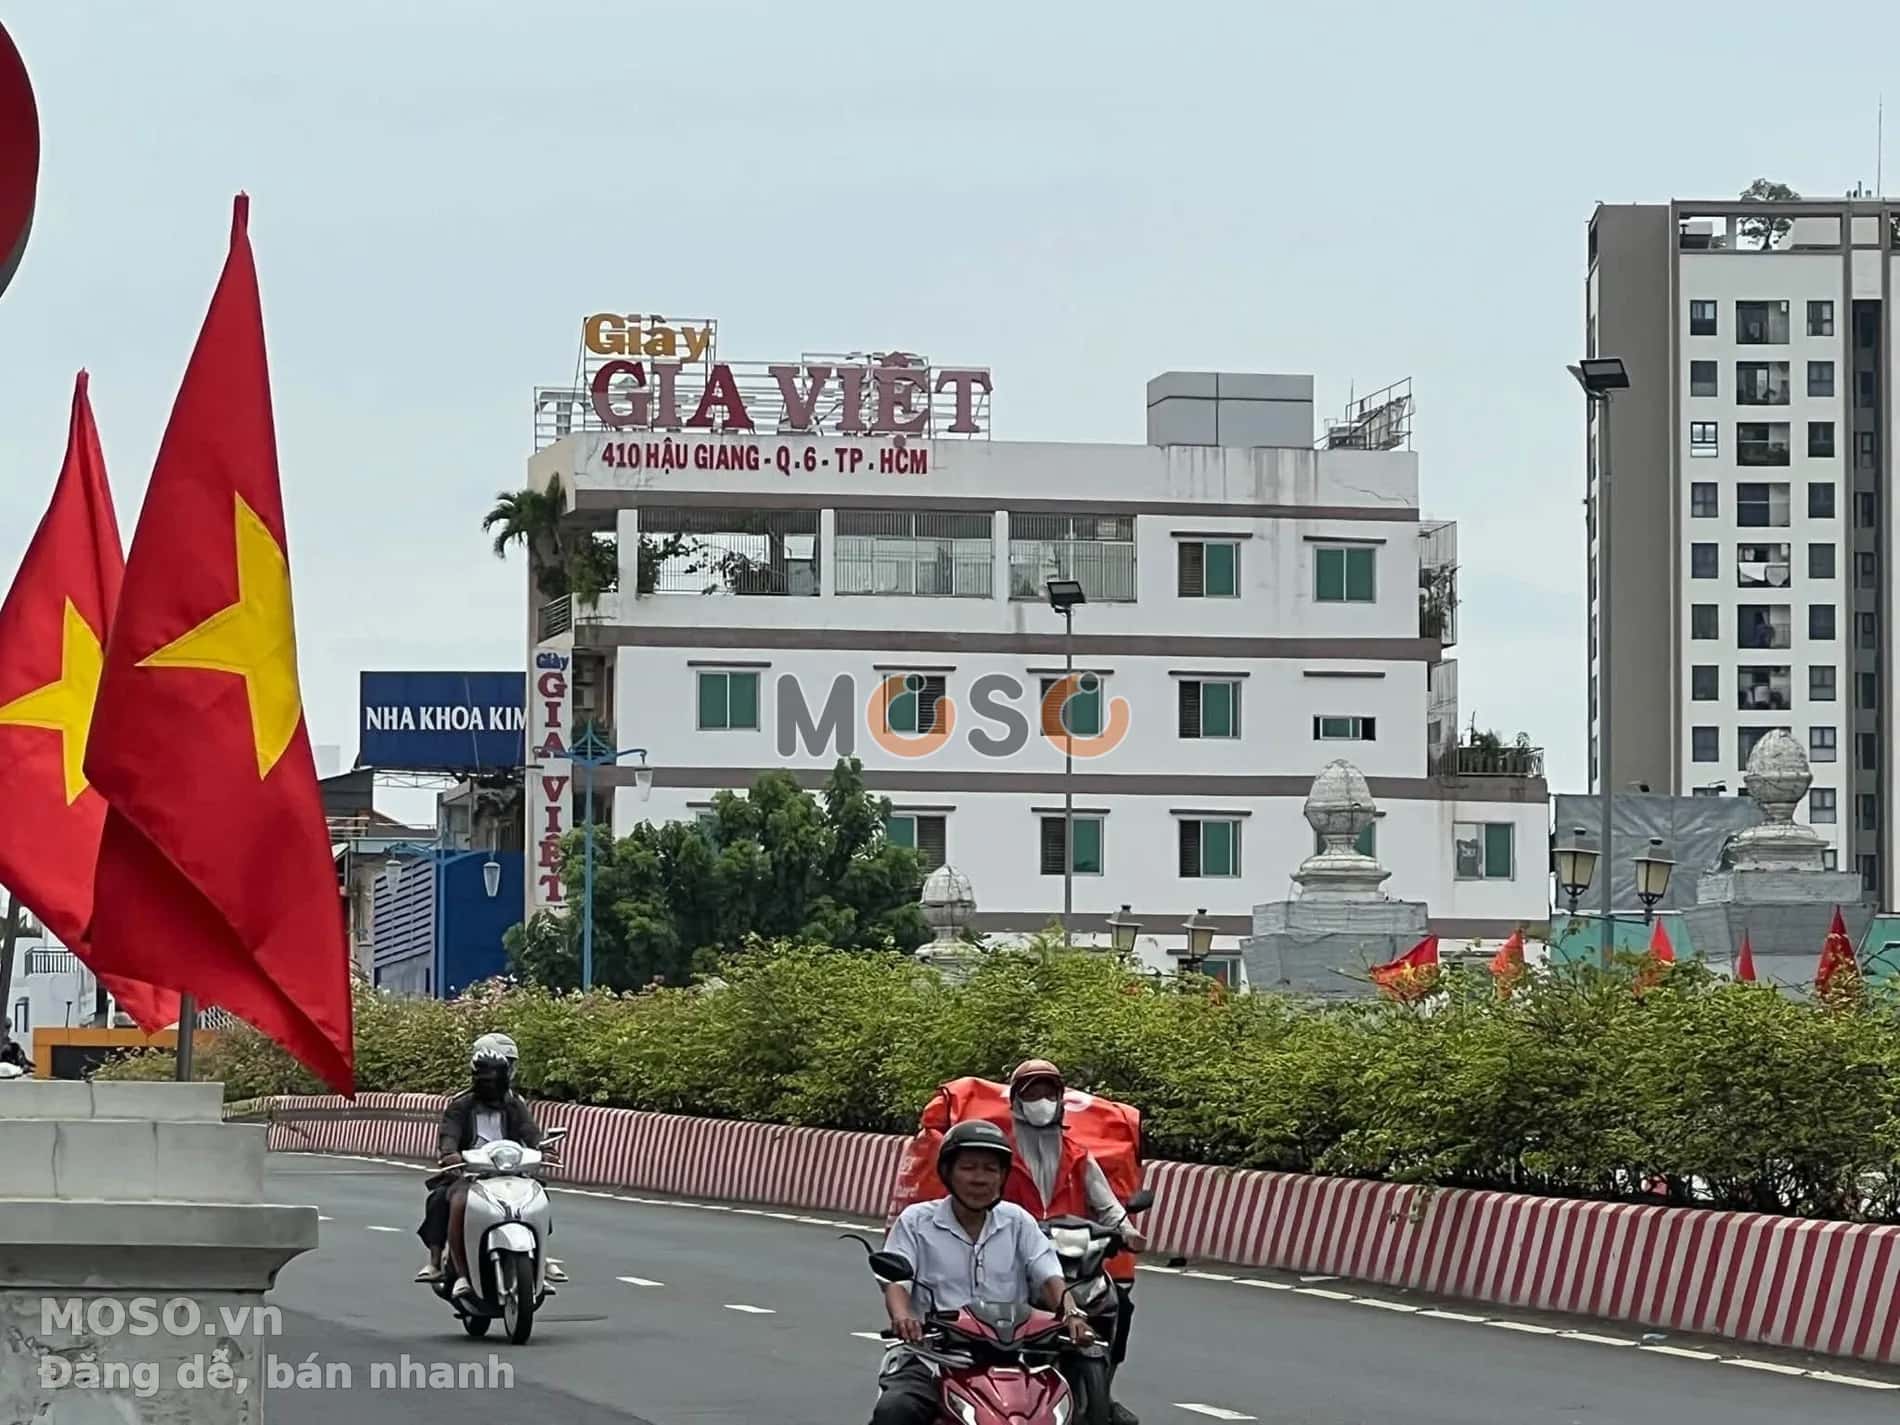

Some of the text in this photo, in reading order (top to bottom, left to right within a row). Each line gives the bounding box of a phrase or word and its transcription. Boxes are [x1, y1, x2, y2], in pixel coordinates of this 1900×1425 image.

[585, 312, 713, 363] Giày
[591, 359, 755, 427] GIA
[768, 351, 993, 448] VIỆT
[602, 442, 640, 468] 410
[646, 436, 688, 474] HẬU
[366, 706, 528, 730] NHA KHOA KIM
[538, 672, 568, 758] GIA
